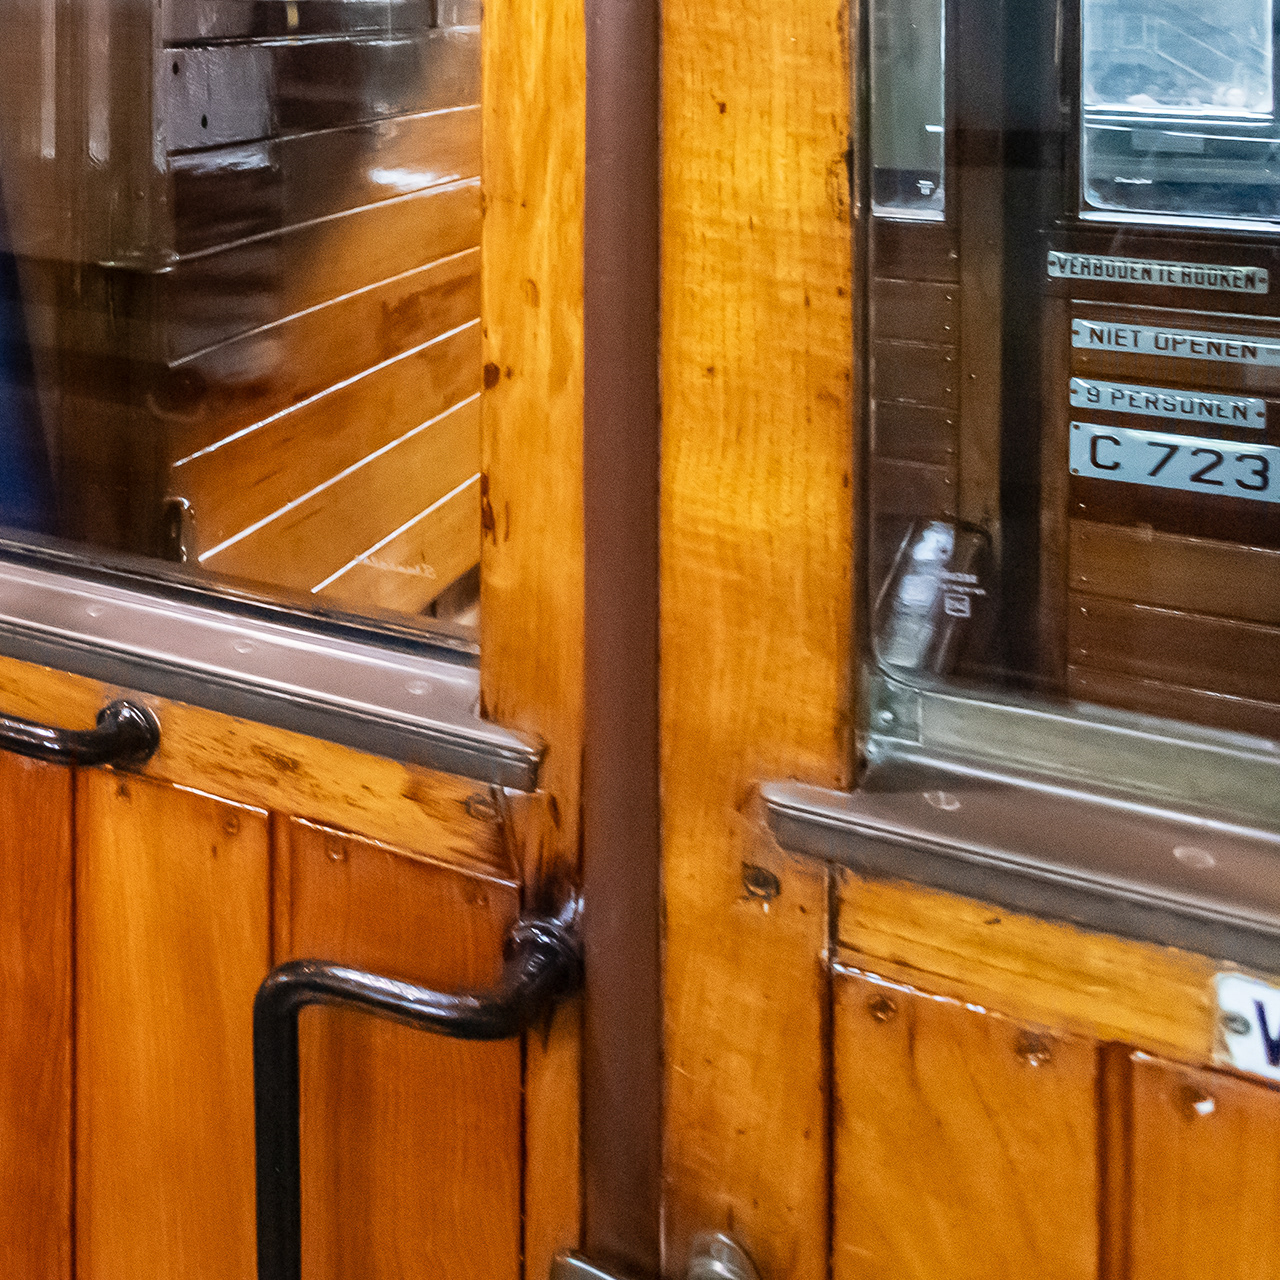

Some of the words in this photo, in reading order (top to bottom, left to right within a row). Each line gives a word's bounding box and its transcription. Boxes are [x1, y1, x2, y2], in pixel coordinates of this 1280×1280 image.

[1089, 327, 1142, 349] NIET
[1154, 332, 1258, 360] OPENEN
[1086, 386, 1100, 404] 9
[1110, 388, 1249, 421] PERSONEN
[1090, 434, 1121, 471] C
[1146, 441, 1271, 492] 723
